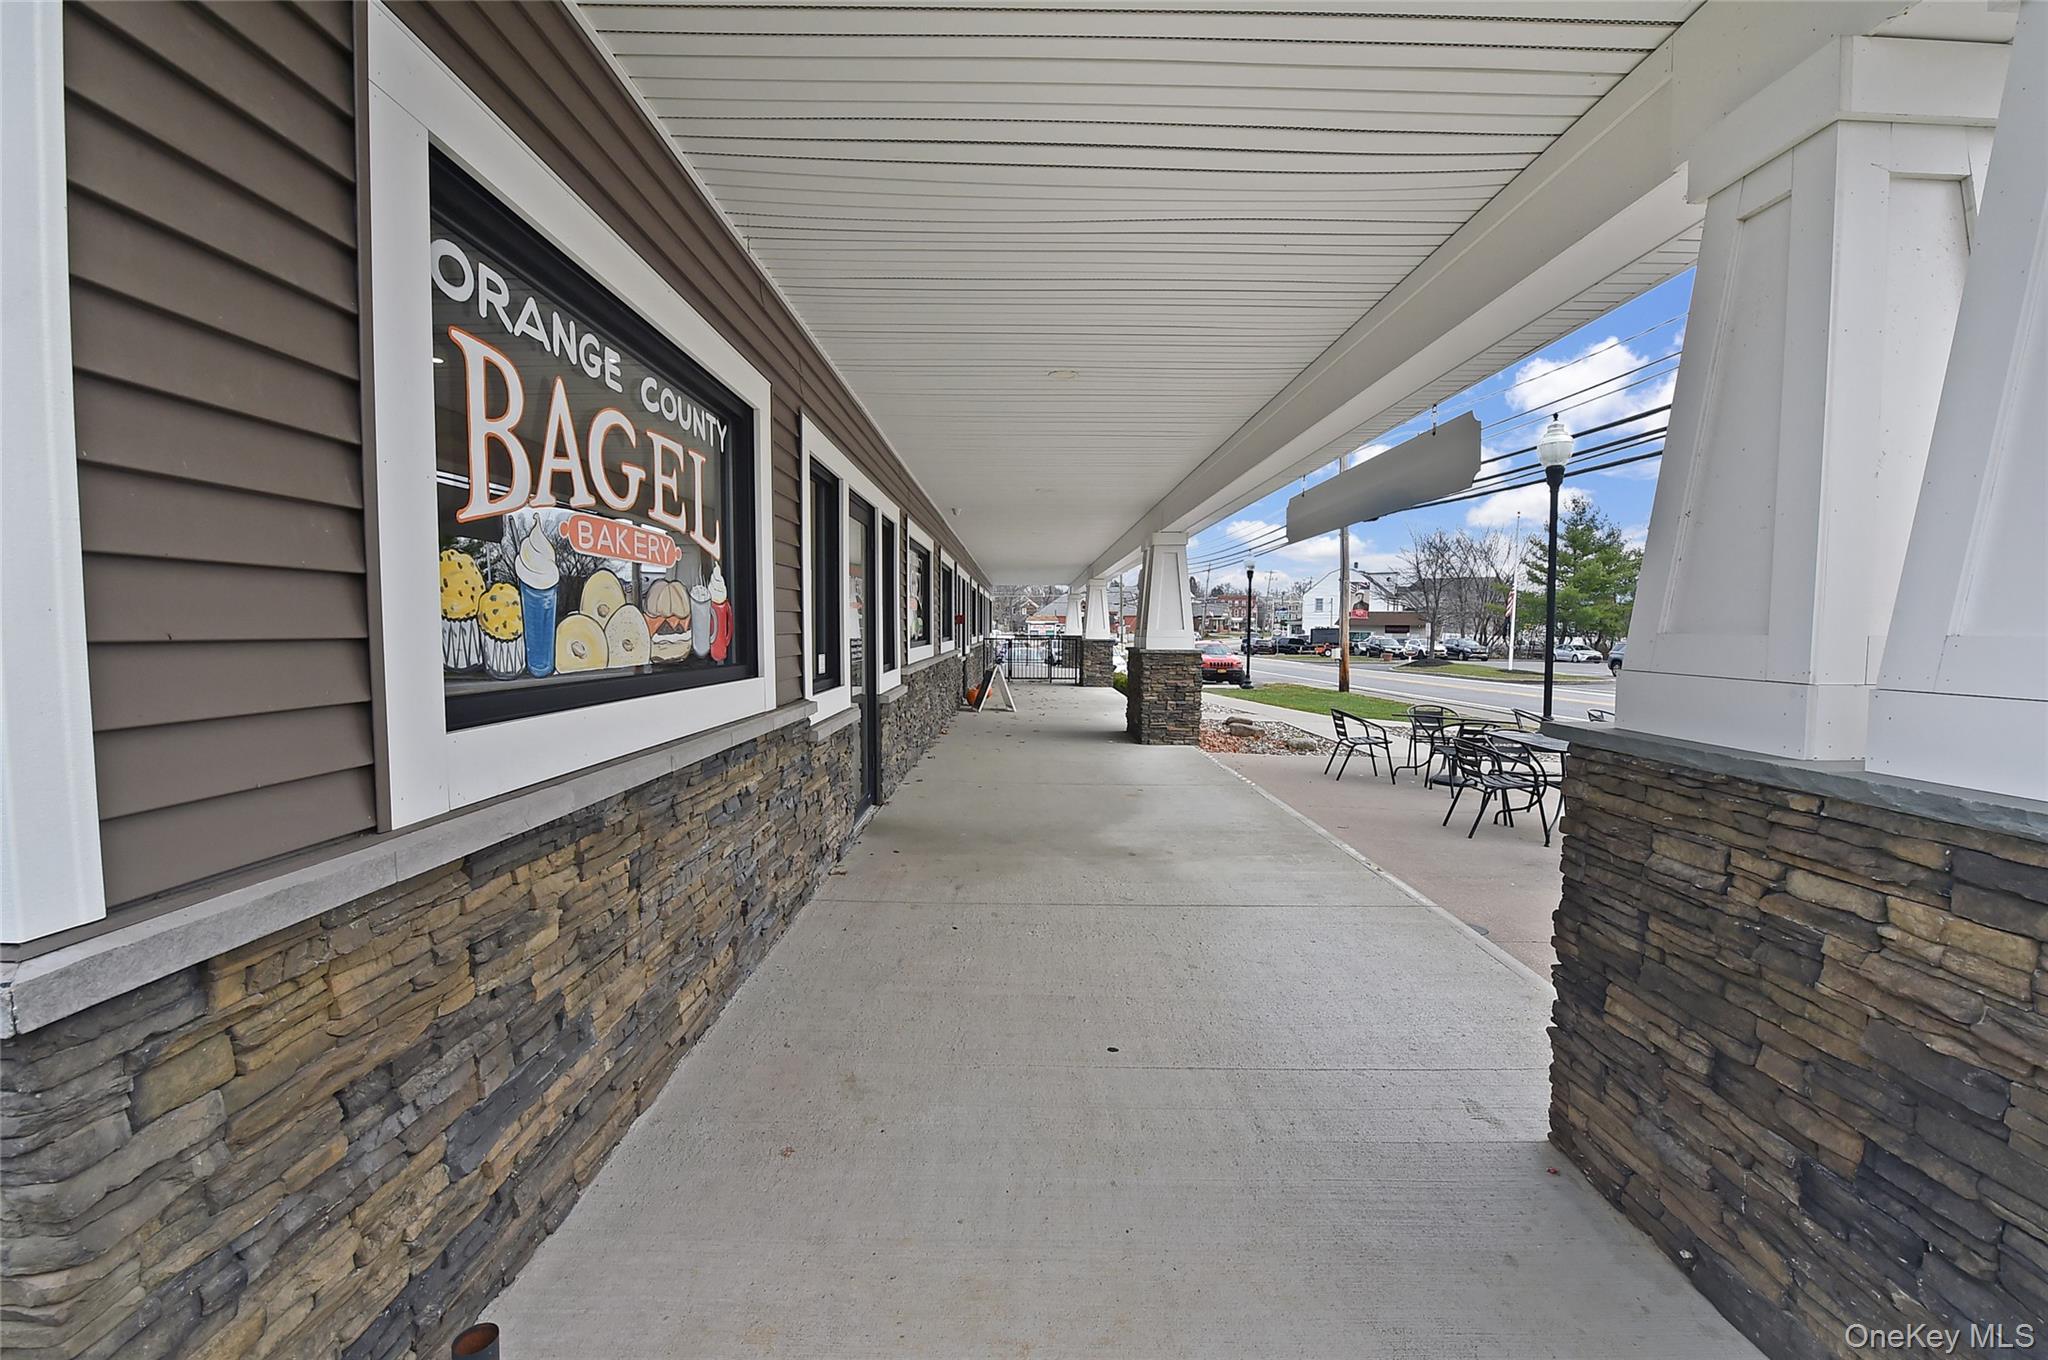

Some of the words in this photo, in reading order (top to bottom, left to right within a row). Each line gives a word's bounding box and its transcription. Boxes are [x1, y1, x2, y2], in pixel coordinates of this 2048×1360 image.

[431, 238, 623, 393] ORANGE
[641, 376, 727, 454] COUNTY
[448, 325, 721, 561] BAGEL
[577, 520, 672, 564] BAKERY
